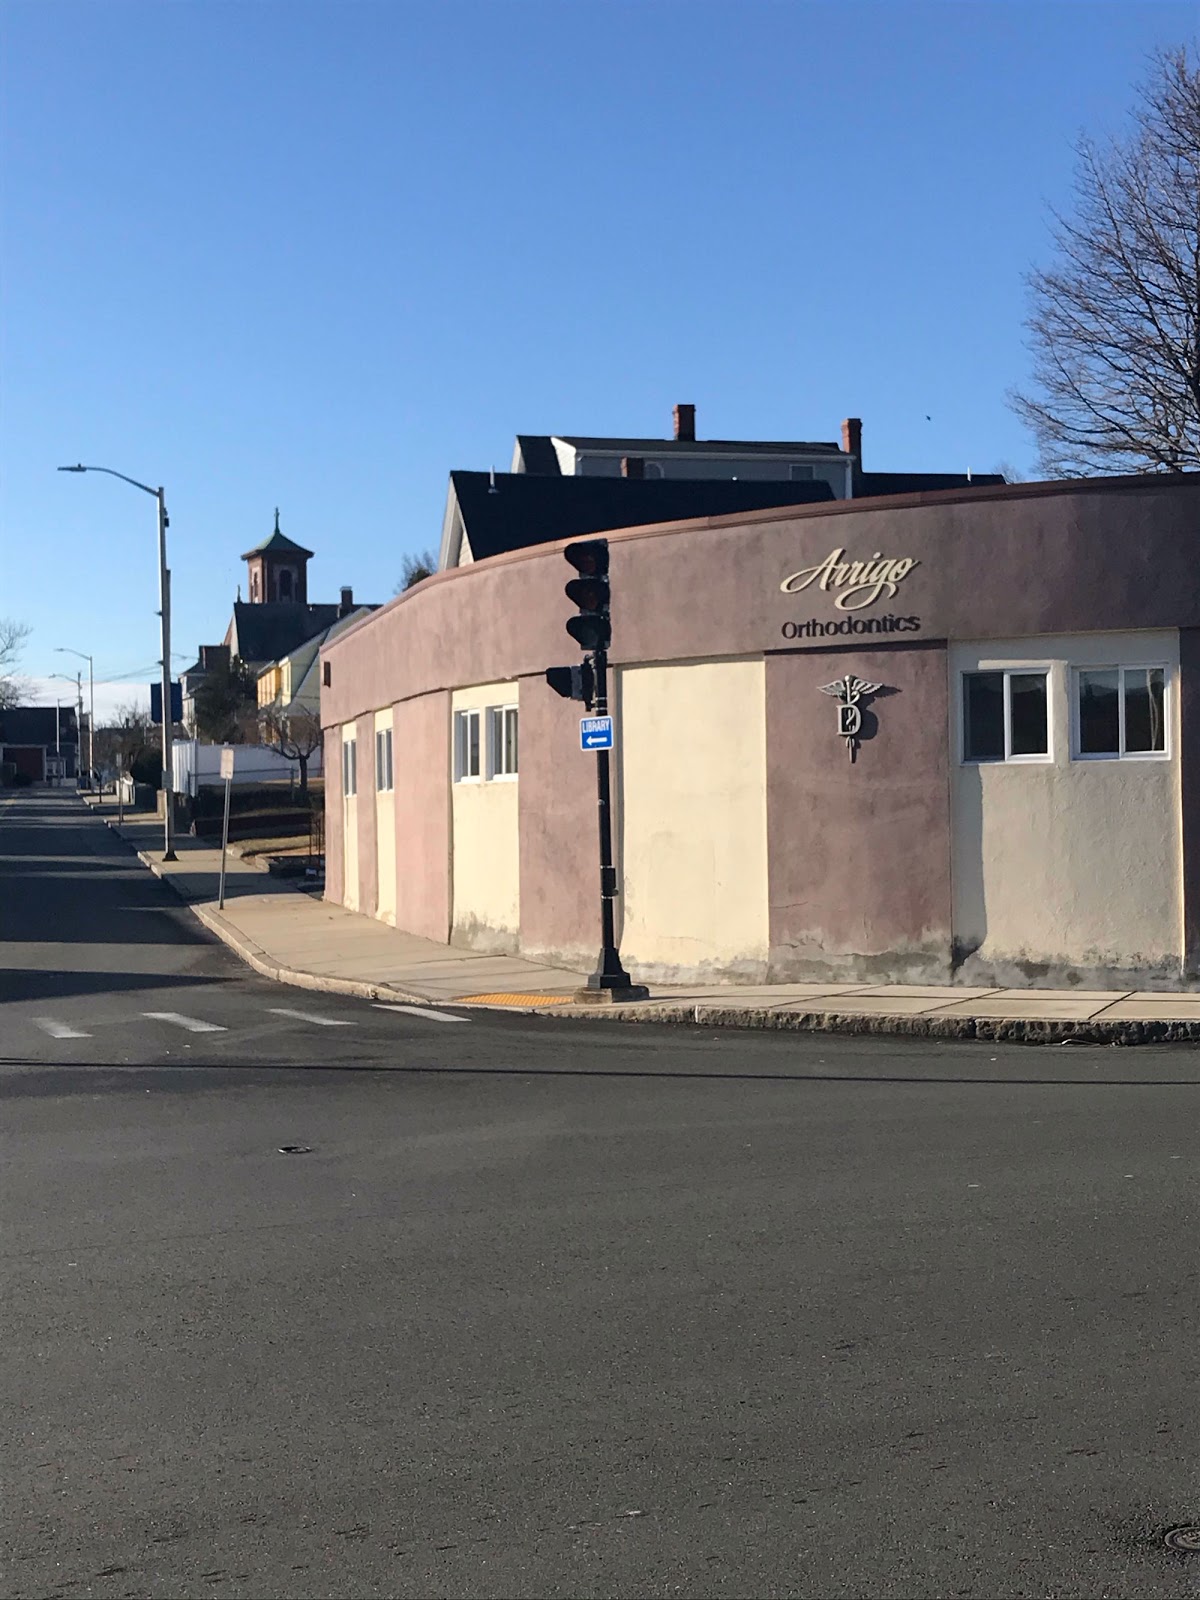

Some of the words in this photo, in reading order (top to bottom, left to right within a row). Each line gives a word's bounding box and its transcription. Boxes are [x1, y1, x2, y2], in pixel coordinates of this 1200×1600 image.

[780, 548, 919, 611] Arrigo
[781, 614, 920, 639] Orthodontics
[582, 719, 610, 733] LIBRARY
